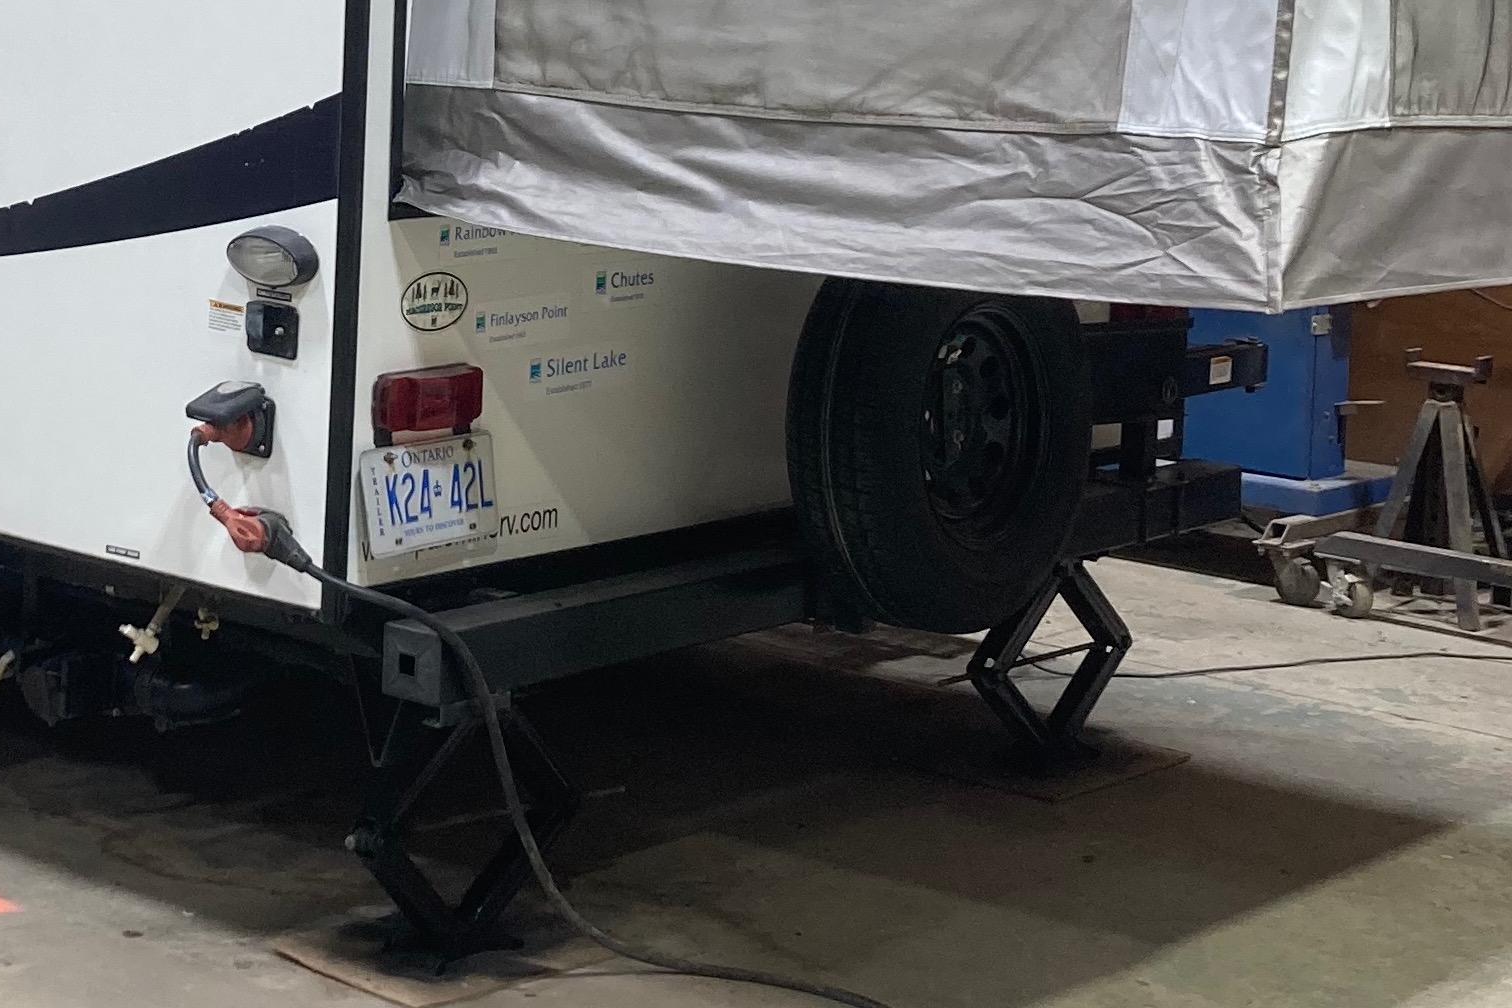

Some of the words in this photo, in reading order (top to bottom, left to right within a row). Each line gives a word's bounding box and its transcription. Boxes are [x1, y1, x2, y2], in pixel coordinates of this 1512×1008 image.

[610, 271, 655, 289] Chutes
[490, 309, 539, 328] Finlayson
[541, 305, 569, 320] Point
[546, 356, 590, 378] Silent
[593, 349, 628, 370] Lake
[400, 445, 455, 469] ONTARIO
[369, 466, 387, 538] TRAILER
[490, 507, 559, 538] rv.com
